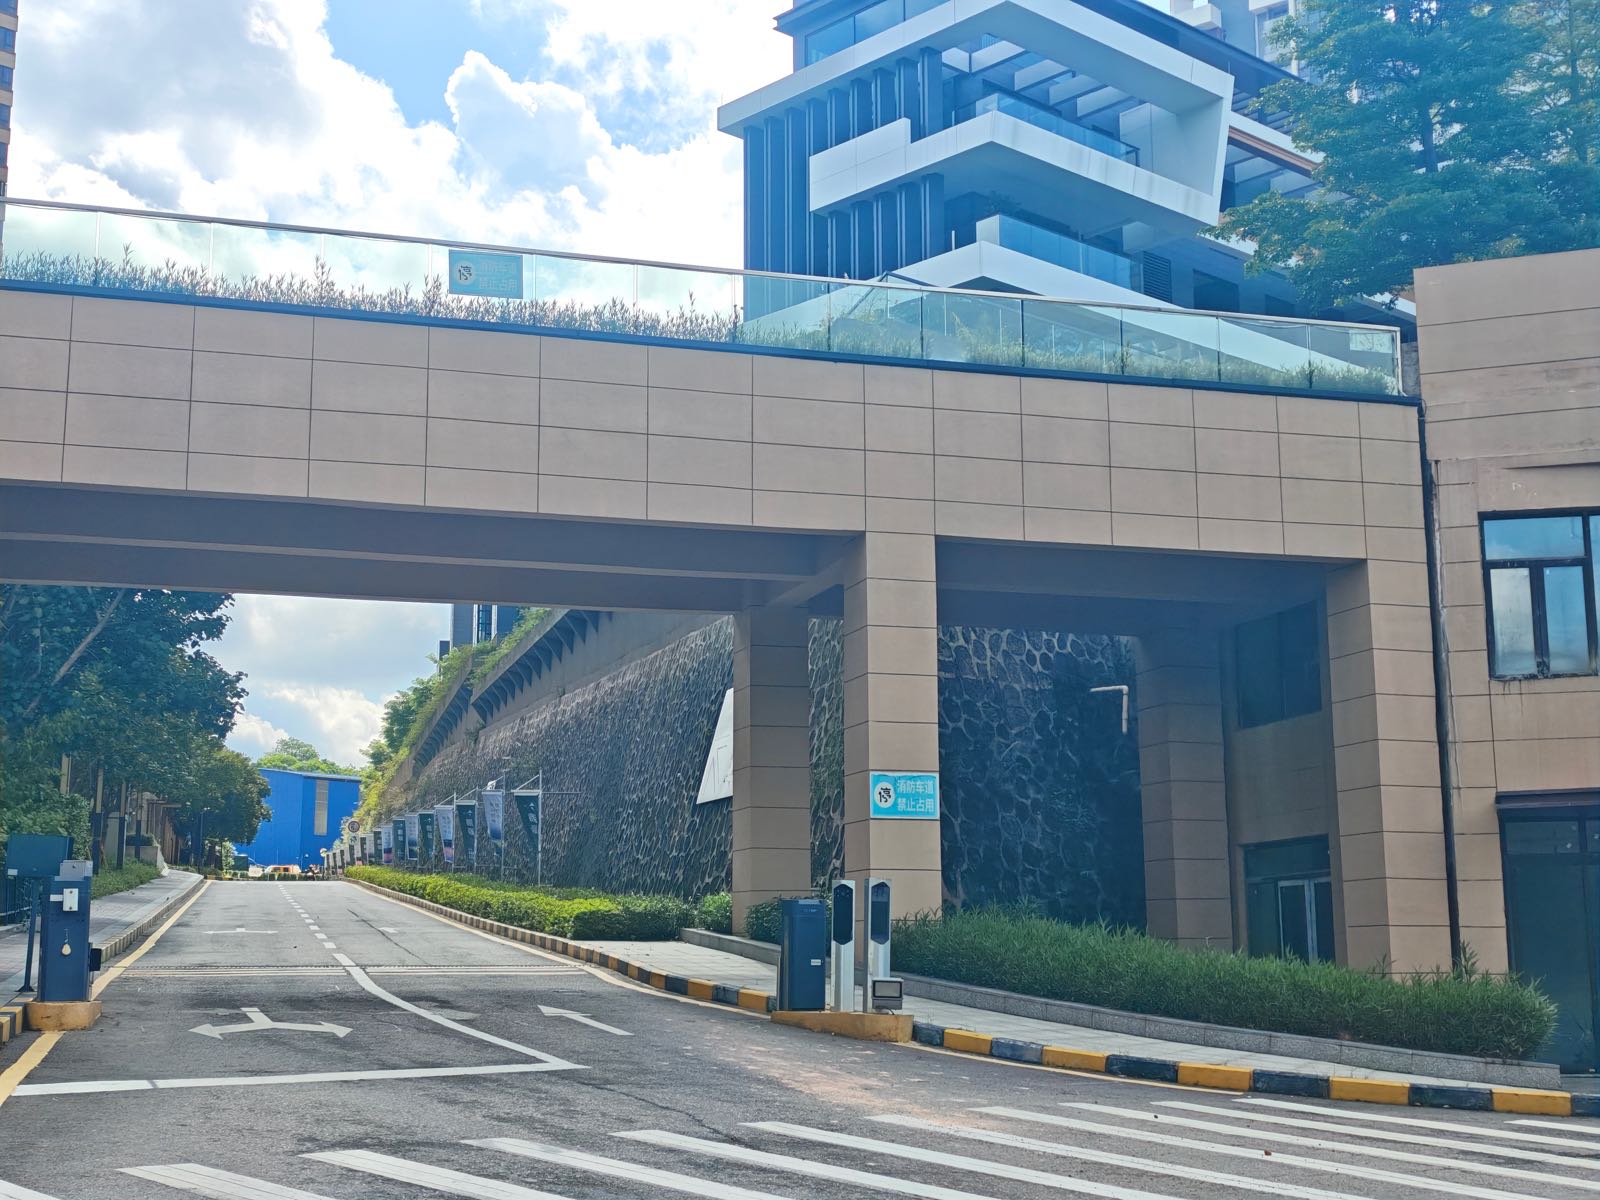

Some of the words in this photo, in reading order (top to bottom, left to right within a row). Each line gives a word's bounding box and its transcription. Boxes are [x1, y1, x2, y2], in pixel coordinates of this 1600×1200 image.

[458, 265, 473, 281] 停
[897, 779, 934, 794] 消防车道
[878, 787, 892, 803] 停
[897, 797, 934, 813] 禁止占用
